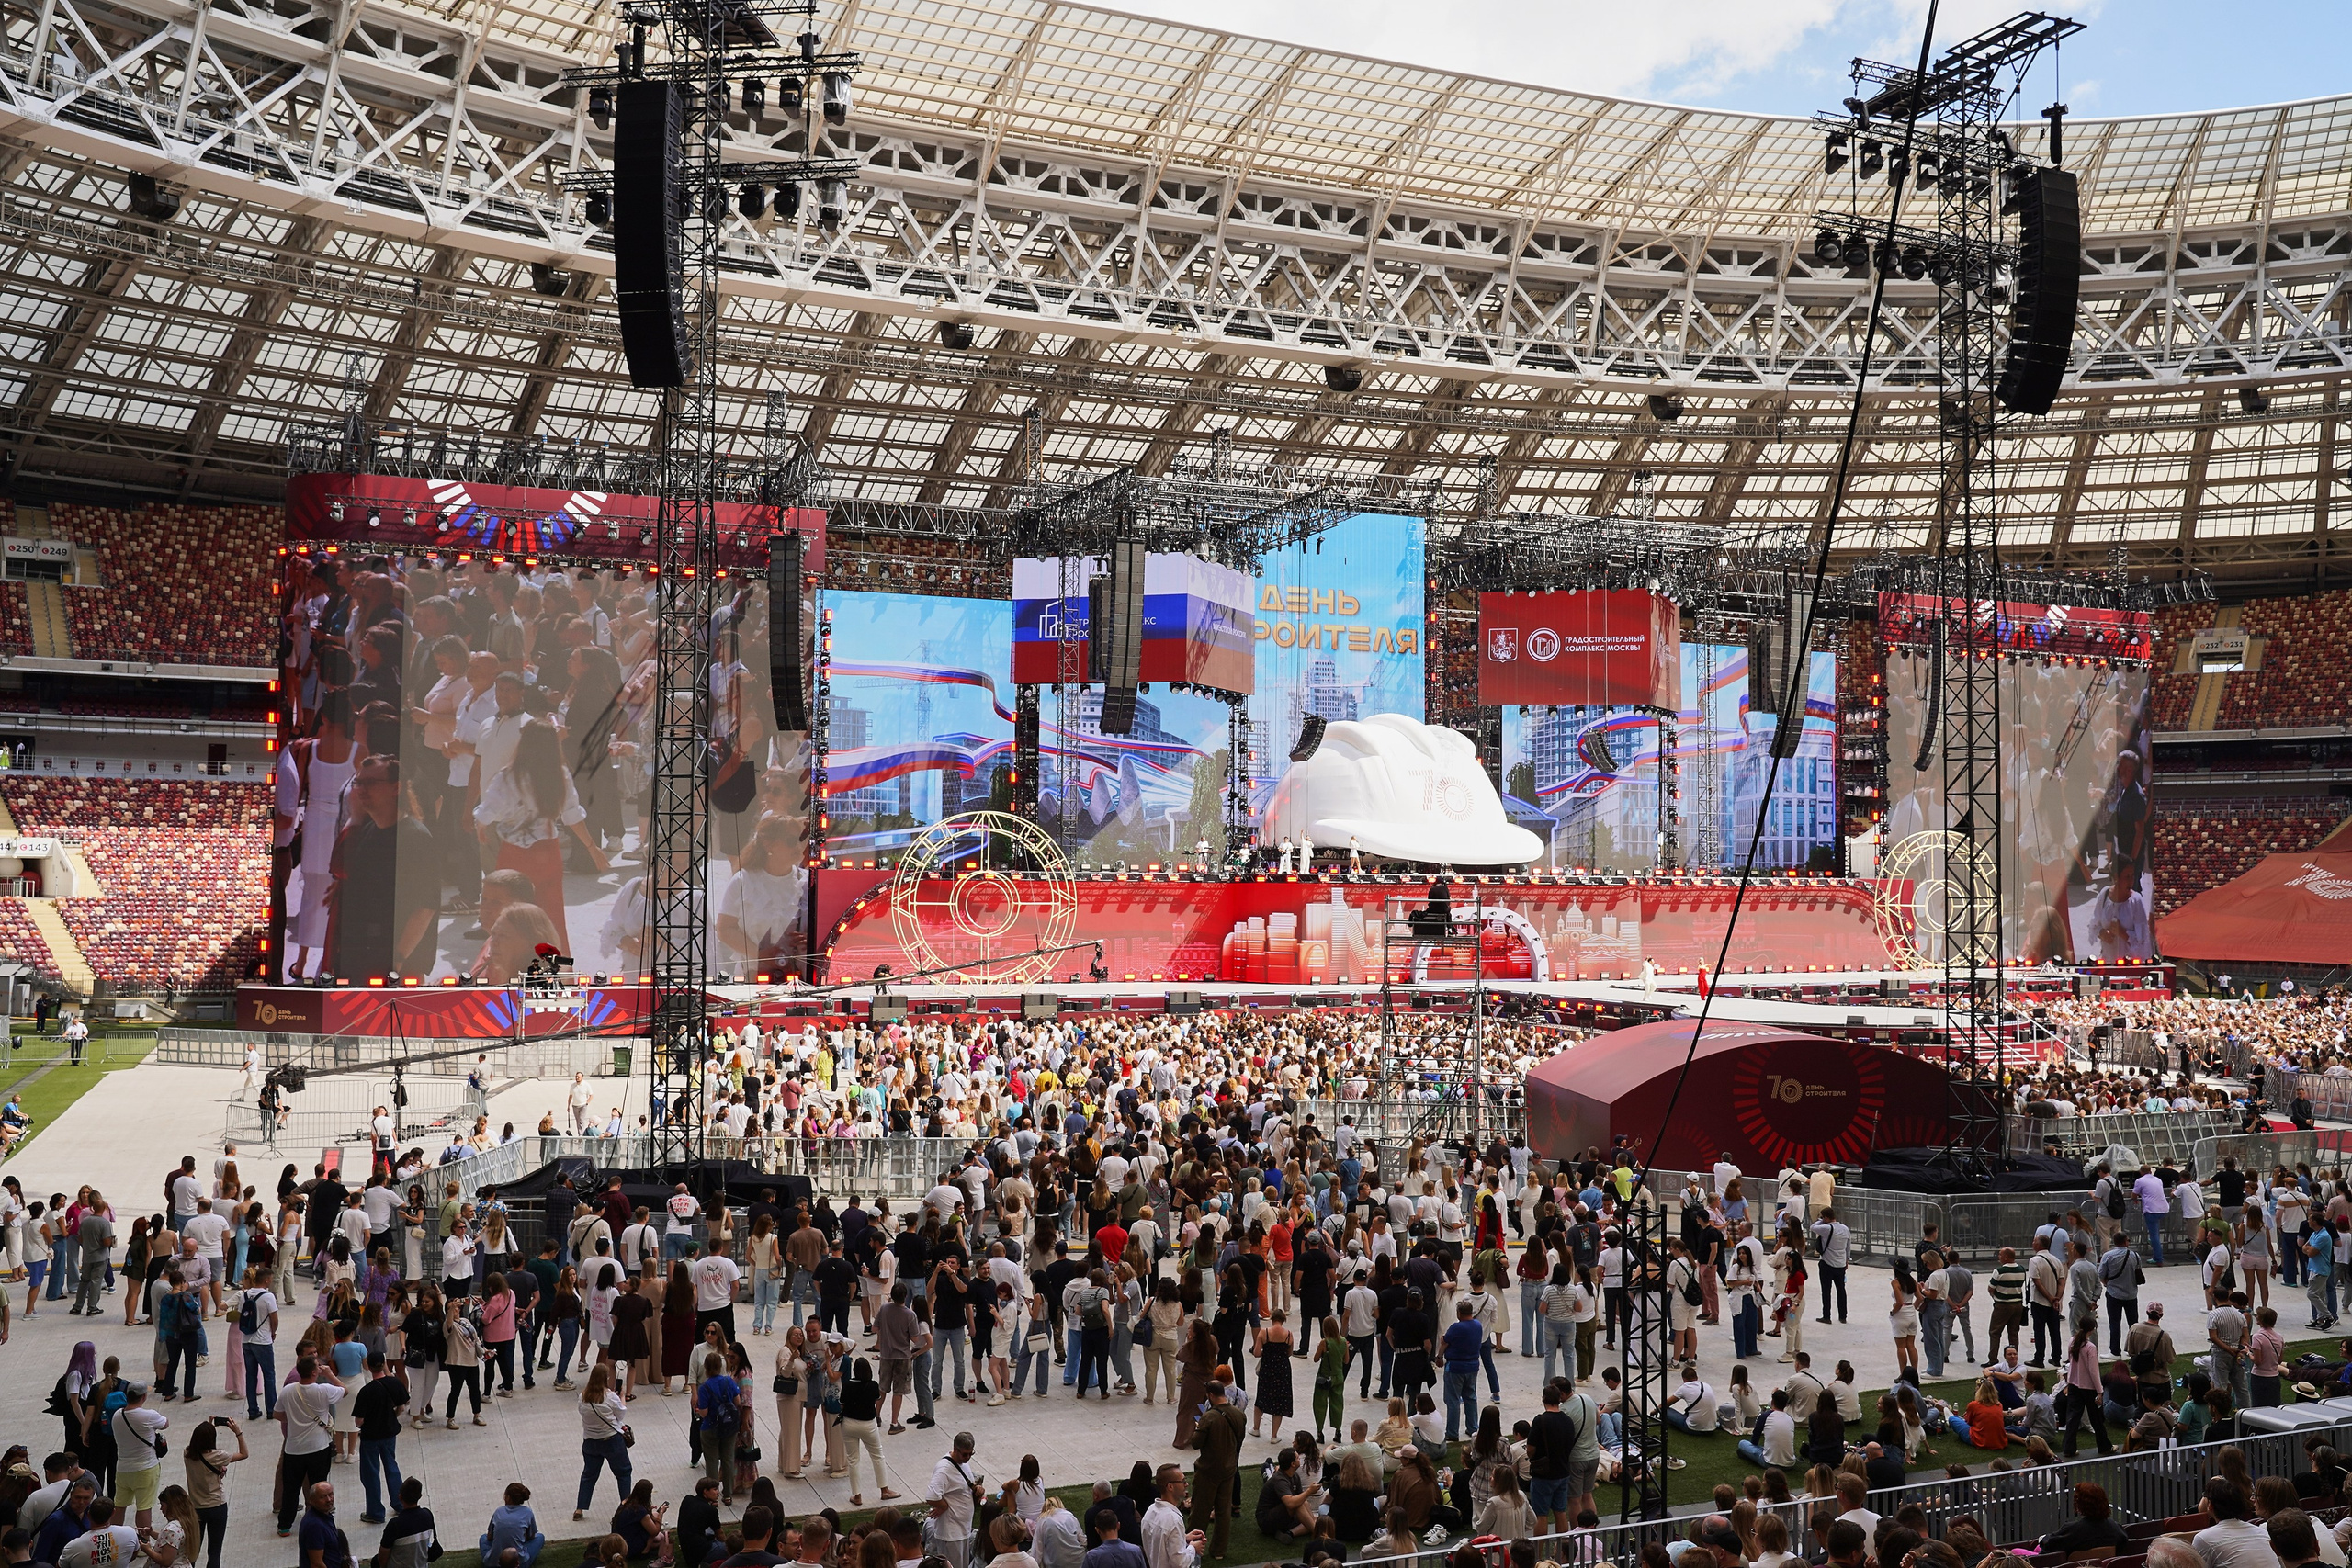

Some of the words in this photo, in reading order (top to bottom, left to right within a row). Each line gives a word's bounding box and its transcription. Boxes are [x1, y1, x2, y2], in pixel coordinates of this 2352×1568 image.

[16, 545, 35, 554] 250
[50, 547, 68, 557] 249
[1259, 584, 1360, 615] ДЕНЬ
[1255, 620, 1418, 654] РОИТЕЛЯ
[1565, 635, 1645, 644] ГРАДОСТРОИТЕЛЬНЫЙ
[1607, 644, 1641, 652] МОСКВЫ
[28, 843, 49, 852] 143
[253, 999, 277, 1025] 70
[1766, 1075, 1803, 1103] 70
